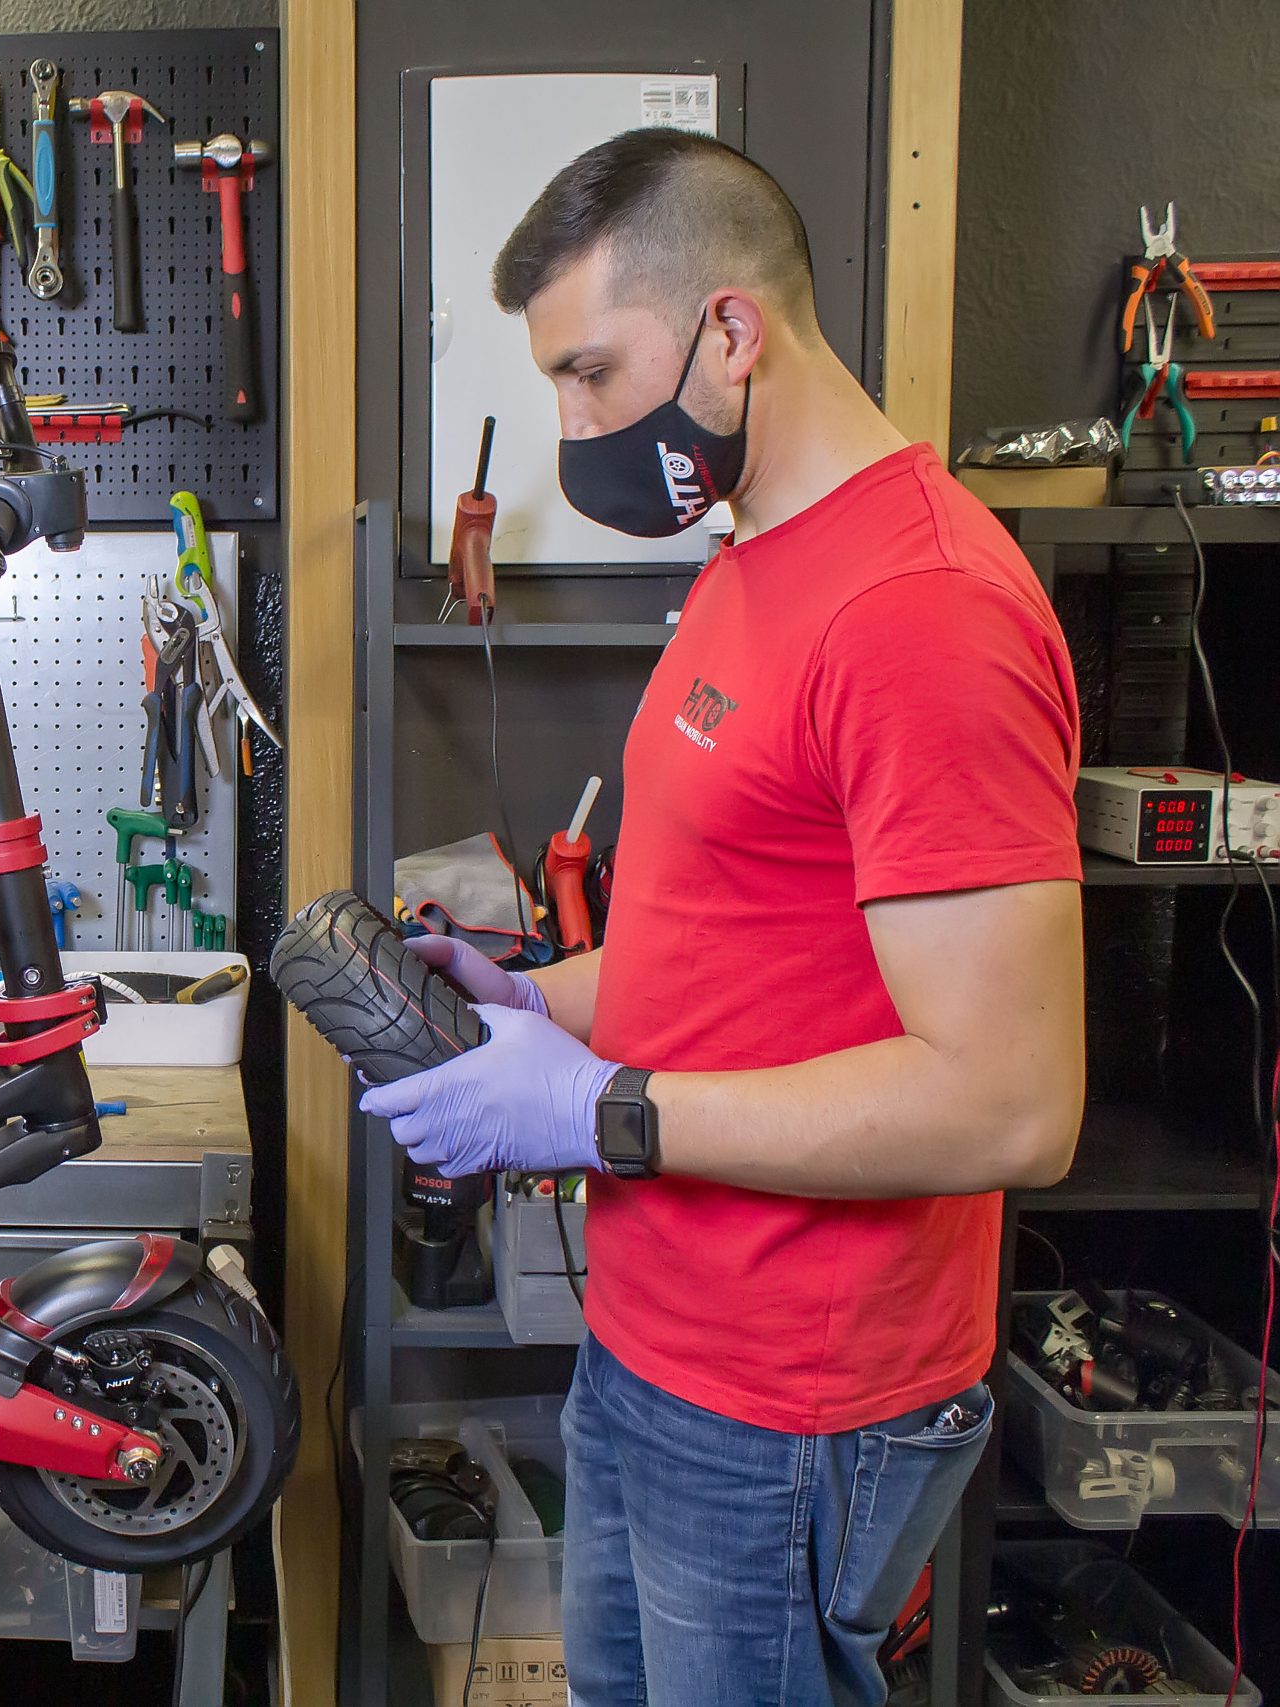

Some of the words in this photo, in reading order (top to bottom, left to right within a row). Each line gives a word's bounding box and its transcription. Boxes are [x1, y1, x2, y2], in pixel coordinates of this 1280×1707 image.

[685, 725, 717, 753] MOBILITY
[415, 1175, 452, 1190] BOSCH
[106, 1376, 135, 1389] NUTT
[472, 1692, 489, 1700] QTY
